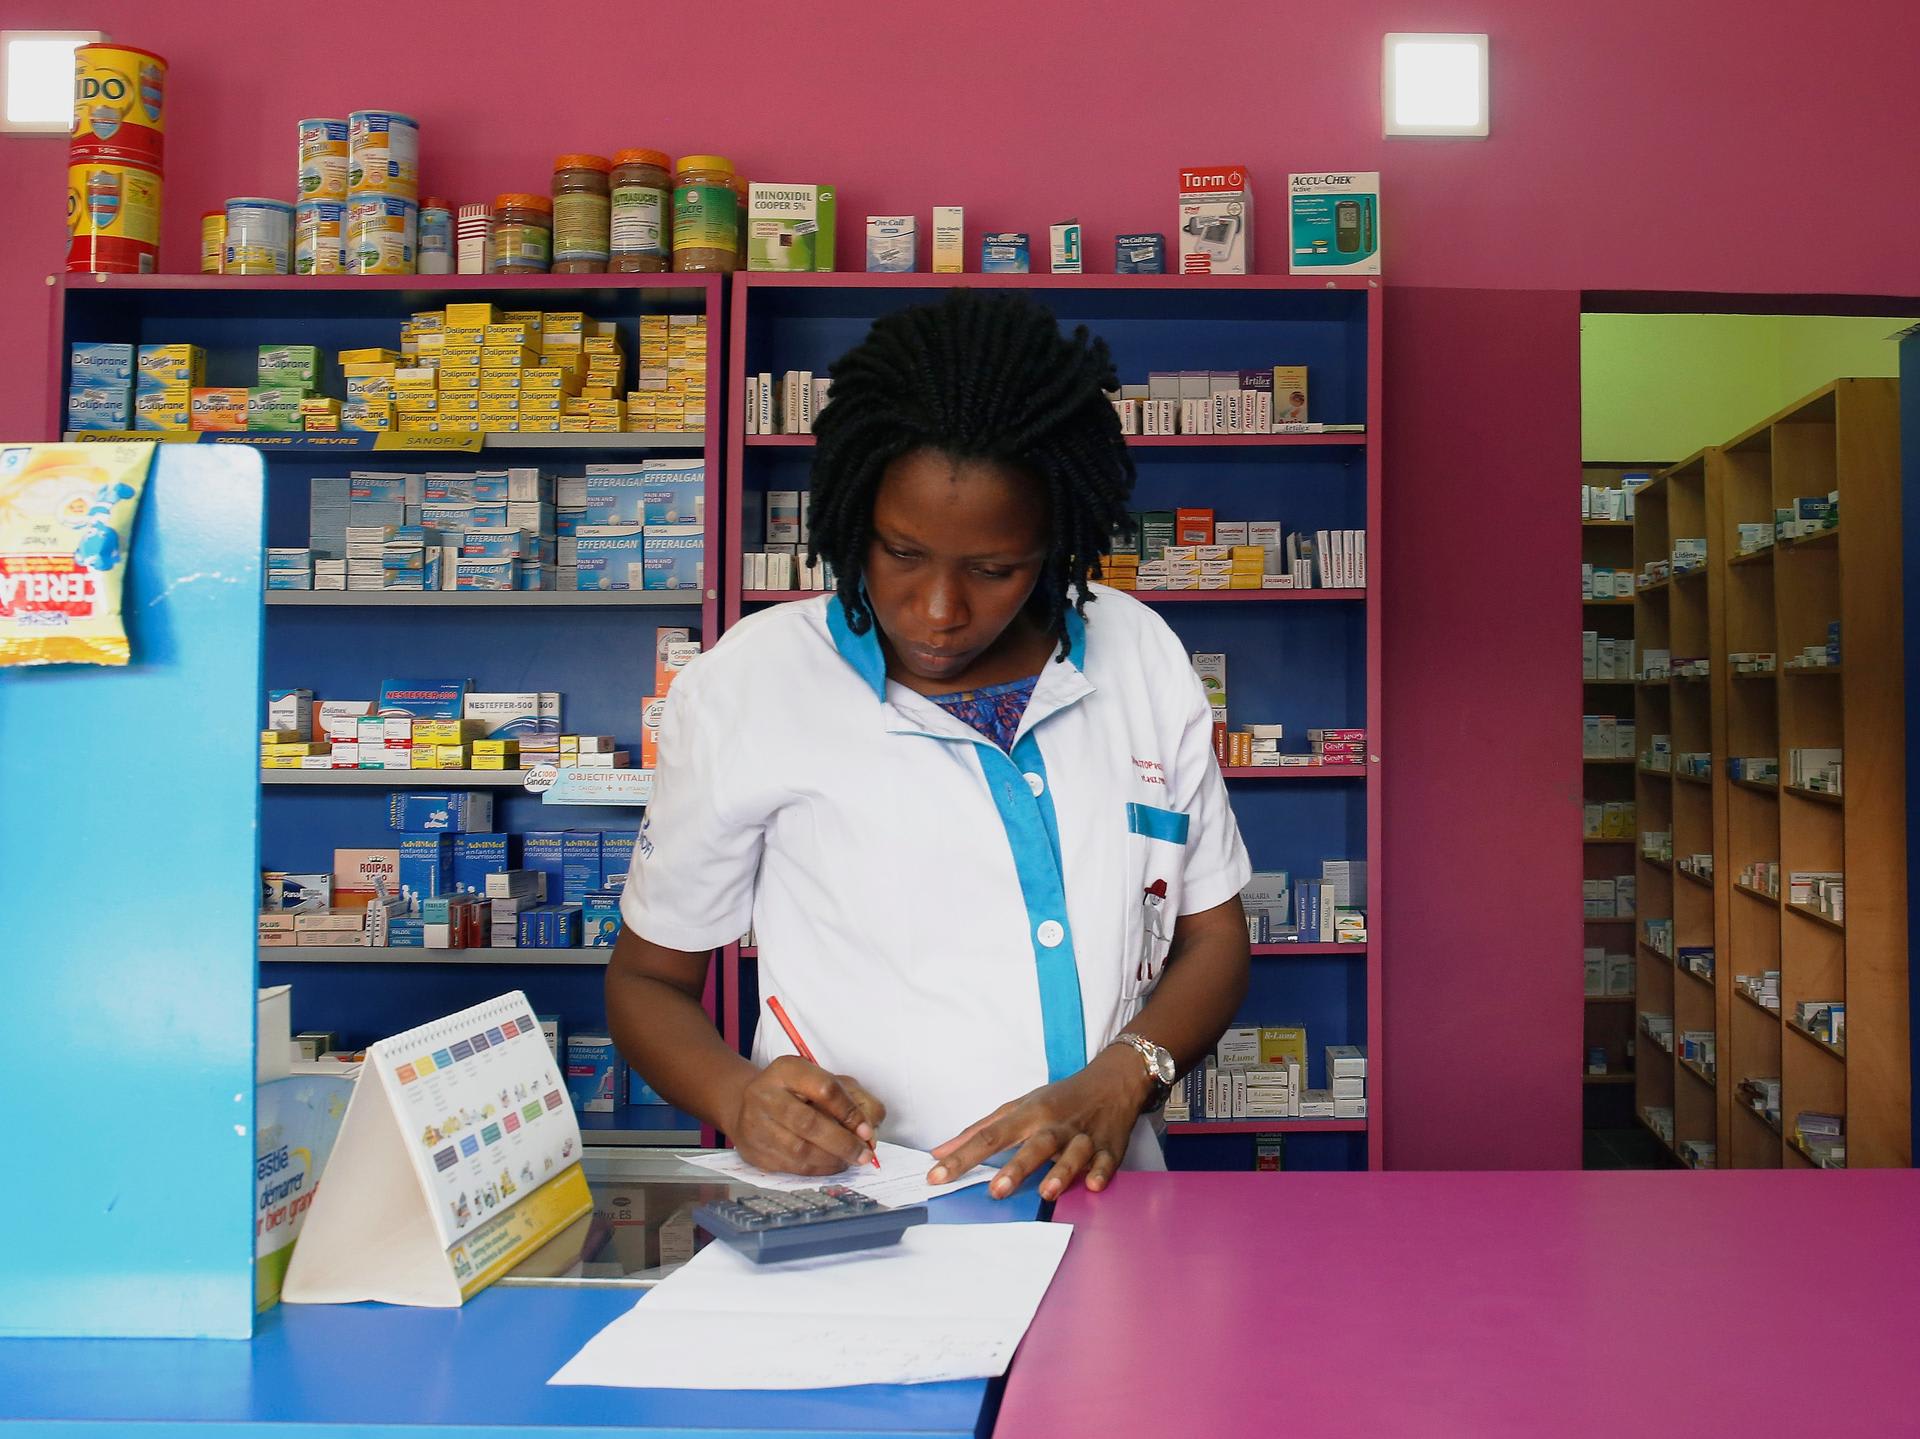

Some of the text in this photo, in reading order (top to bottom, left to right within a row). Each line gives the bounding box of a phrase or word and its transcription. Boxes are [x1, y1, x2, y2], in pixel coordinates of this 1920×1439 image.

[1182, 172, 1226, 189] Torm
[1290, 173, 1353, 188] ACCU-CHEK
[754, 190, 813, 202] MINOXIDIL
[754, 201, 792, 211] COOPER
[74, 353, 129, 368] Doliprane
[71, 397, 123, 412] Doliprane
[406, 437, 456, 446] SANOFI
[466, 534, 514, 545] EFFERALGAN
[577, 539, 638, 551] EFFERALGAN
[644, 539, 705, 551] EFFERALGAN
[458, 565, 506, 576] EFFERALGAN
[468, 701, 532, 710] NESTEFFER-500
[568, 772, 616, 782] OBJECTIF
[360, 862, 394, 874] ROIPAR
